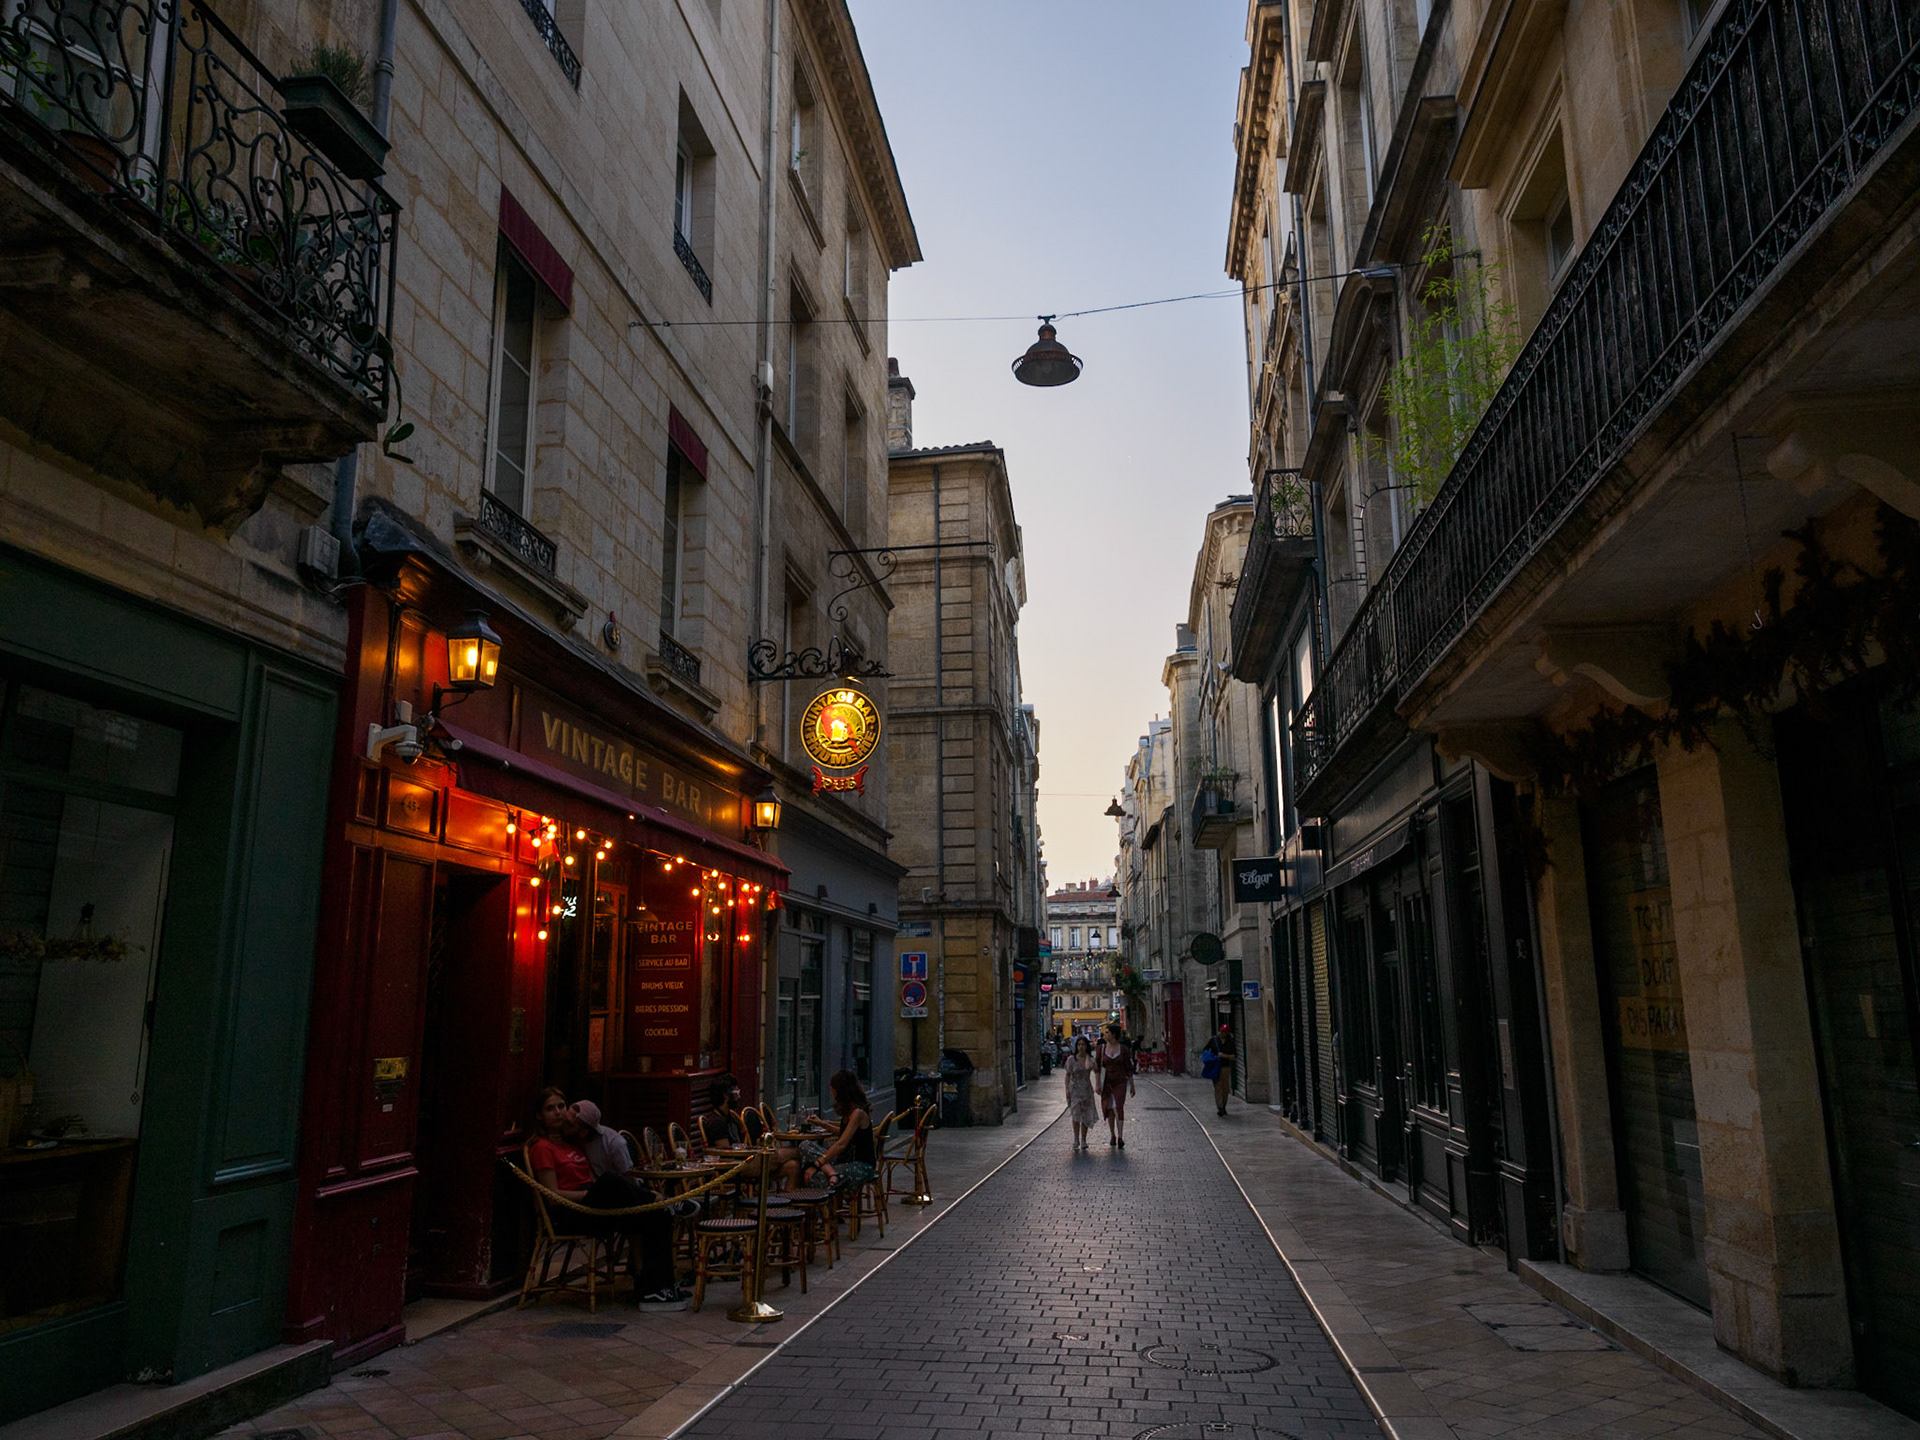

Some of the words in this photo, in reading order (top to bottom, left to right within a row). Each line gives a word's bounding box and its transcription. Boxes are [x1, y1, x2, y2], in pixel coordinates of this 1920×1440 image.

[805, 691, 855, 727] VINTAGE
[855, 698, 876, 726] BAR
[804, 730, 876, 765] RHUMERIE
[542, 711, 649, 791] VINTAGE
[663, 772, 701, 814] BAR
[821, 776, 857, 790] PUB
[1239, 869, 1273, 889] Edgar
[636, 921, 693, 932] VINTAGE
[650, 934, 677, 944] BAR
[638, 959, 664, 967] SERVICE
[664, 958, 674, 966] AU
[674, 957, 688, 966] BAR
[641, 982, 664, 990] RHUMS
[664, 981, 684, 990] VIEUX
[657, 1004, 689, 1013] PRESSION
[644, 1028, 678, 1037] COCKTAILS
